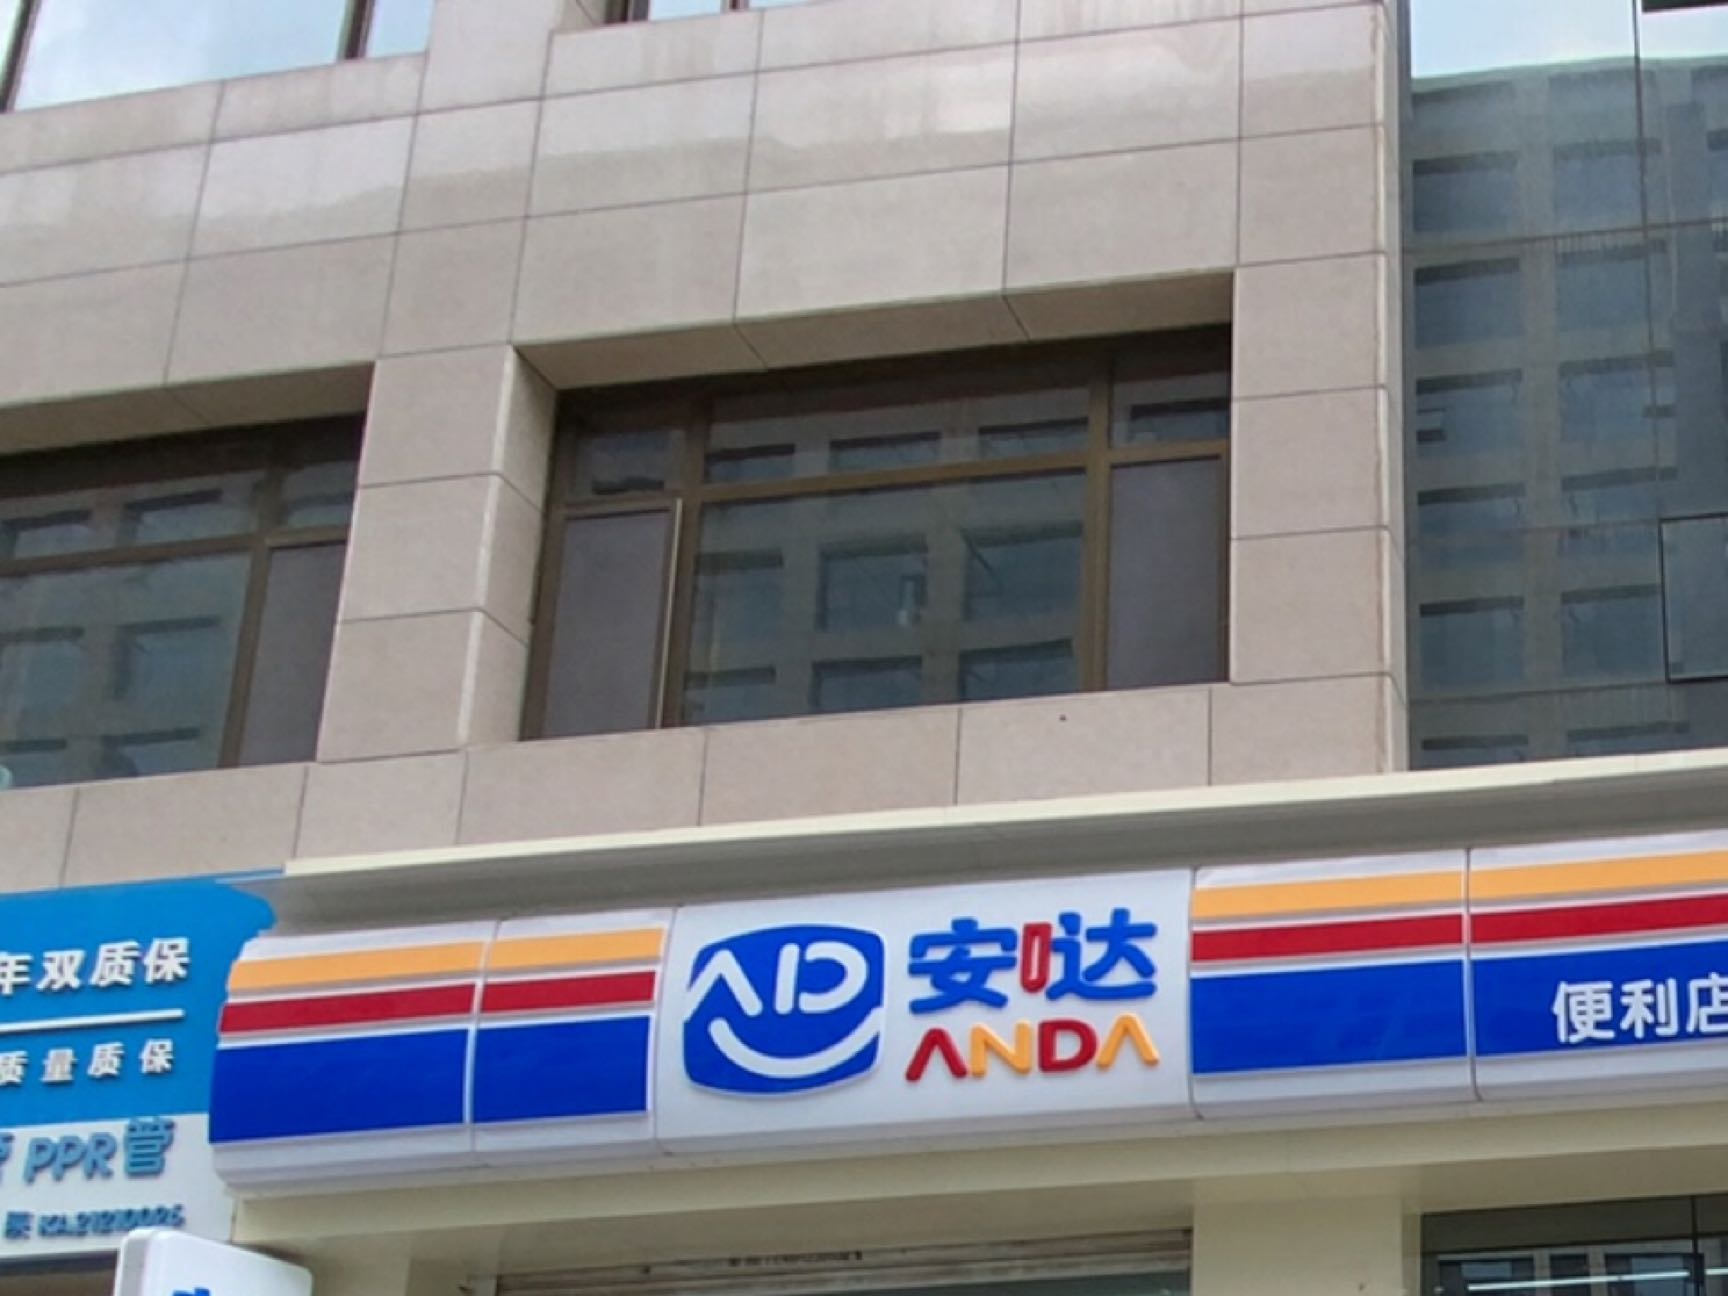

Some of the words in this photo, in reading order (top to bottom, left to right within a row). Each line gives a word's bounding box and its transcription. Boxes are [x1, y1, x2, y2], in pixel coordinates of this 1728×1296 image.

[0, 937, 192, 995] 年双质保
[905, 1014, 1160, 1082] ANDA
[0, 1116, 175, 1184] PPR管
